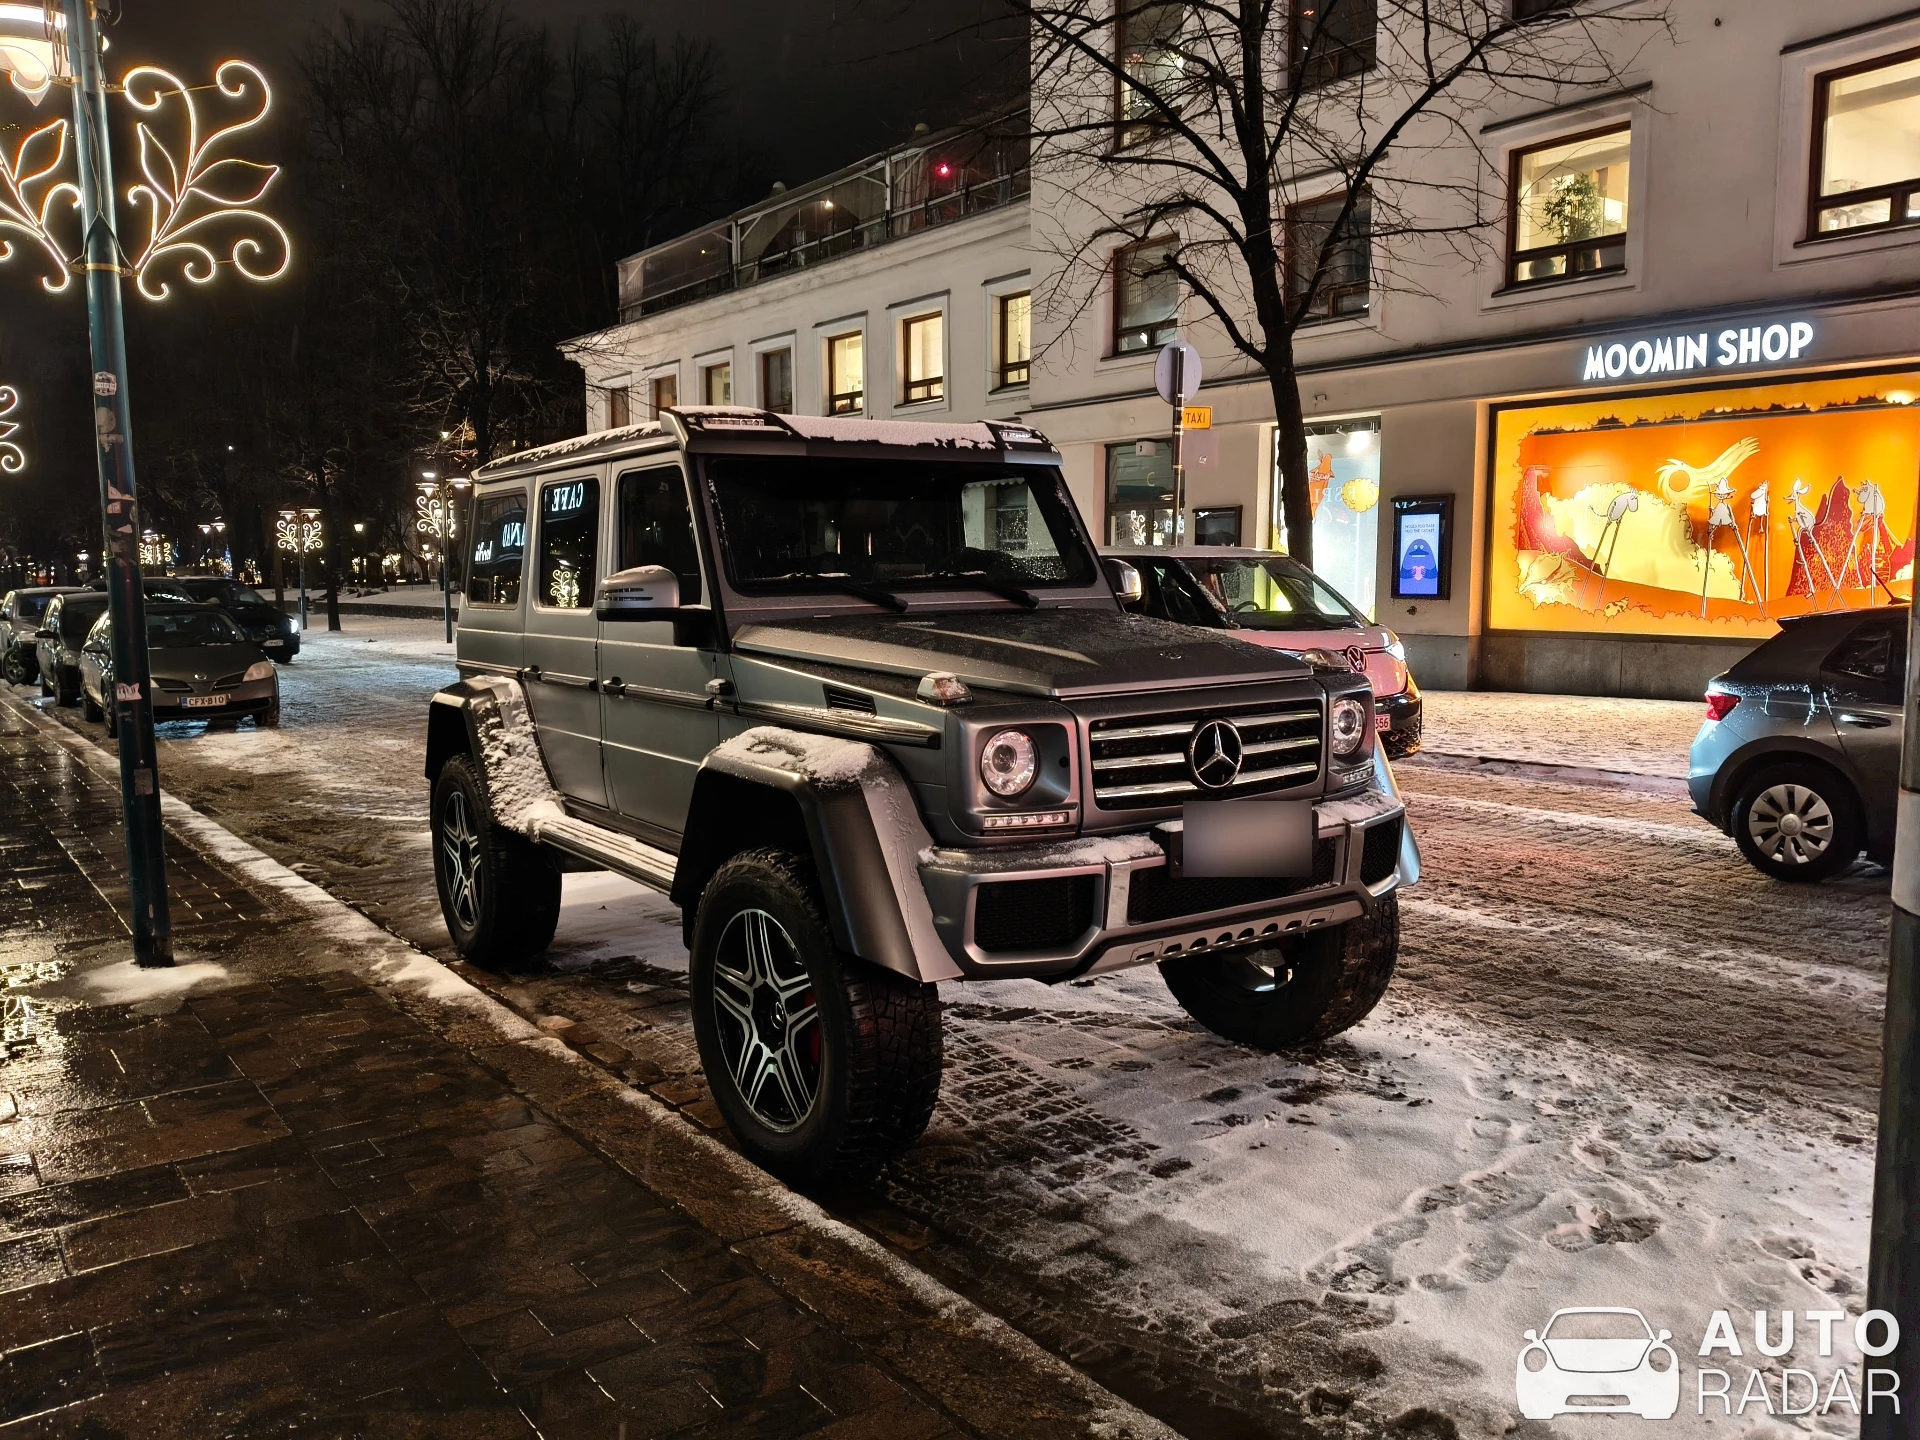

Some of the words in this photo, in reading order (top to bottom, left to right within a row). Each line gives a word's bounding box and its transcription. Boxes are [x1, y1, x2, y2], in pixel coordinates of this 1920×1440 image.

[1584, 333, 1708, 381] MOOMIN
[1717, 322, 1814, 366] SHOP
[1185, 412, 1206, 424] TAXI
